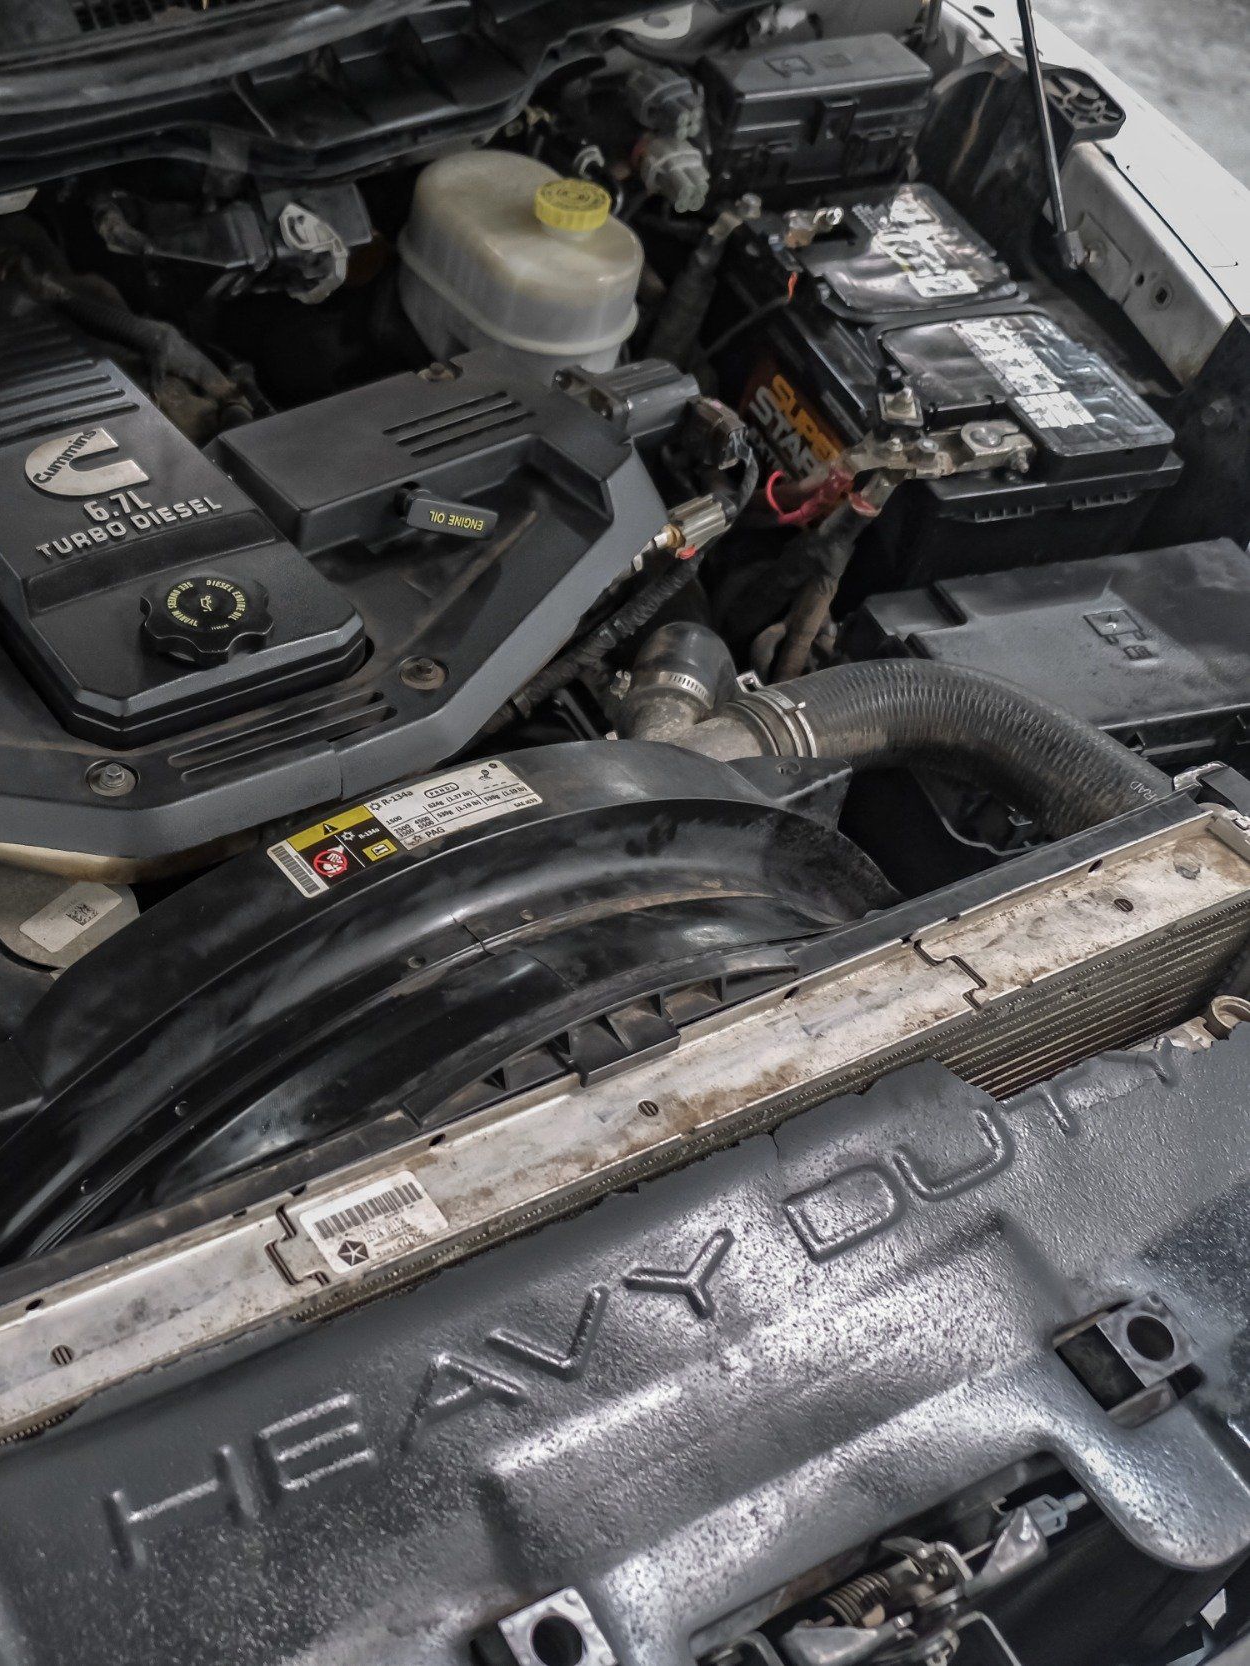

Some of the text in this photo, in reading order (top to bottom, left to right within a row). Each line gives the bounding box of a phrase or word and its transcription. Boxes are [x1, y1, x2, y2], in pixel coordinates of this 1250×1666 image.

[32, 430, 97, 484] Cummins
[83, 490, 152, 522] 6.7L
[36, 496, 222, 557] TURBO DIESEL
[430, 510, 484, 531] ENGINE OIL
[178, 581, 194, 591] SEE
[206, 579, 234, 592] DIESEL
[228, 611, 242, 621] OIL
[171, 610, 198, 627] MANUAL
[381, 788, 414, 807] R-134a
[386, 816, 402, 825] 1500
[414, 816, 431, 826] 4500
[425, 826, 445, 838] PAG
[106, 1227, 734, 1567] HEAVY
